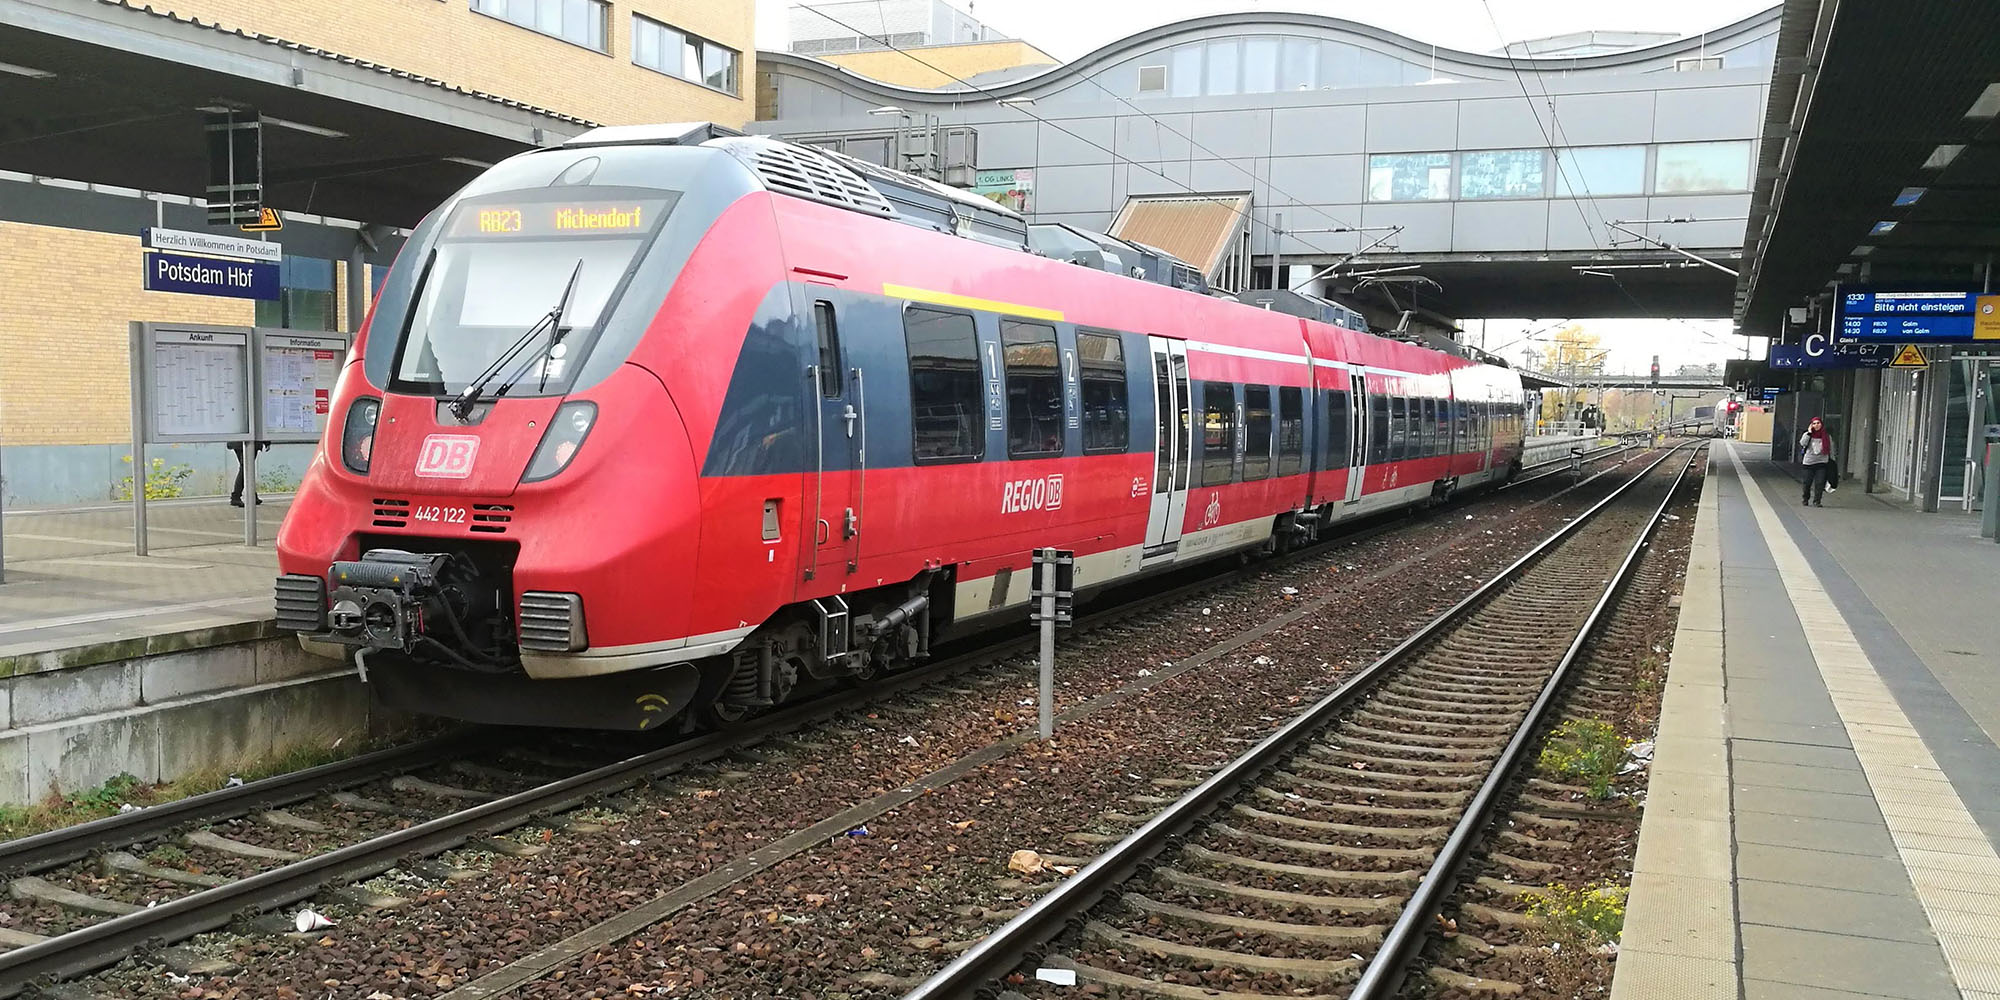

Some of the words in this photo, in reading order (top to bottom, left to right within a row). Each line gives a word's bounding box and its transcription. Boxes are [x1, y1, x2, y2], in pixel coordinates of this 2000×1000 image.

[479, 210, 522, 232] RB23
[555, 206, 641, 230] Michendorf
[155, 233, 187, 246] Herzlich
[188, 237, 235, 252] Willkommen
[236, 242, 244, 252] in
[245, 244, 278, 257] Potsdam!
[158, 259, 224, 285] Potsdam
[228, 266, 253, 288] Hbf
[1874, 303, 1895, 312] Bitte
[1896, 303, 1918, 311] nicht
[1920, 303, 1965, 313] einsteigen
[189, 333, 213, 342] Ankunft
[289, 338, 321, 347] Information
[1805, 334, 1825, 357] C
[988, 344, 997, 379] 1
[1066, 351, 1075, 382] 2
[422, 440, 472, 472] DB
[1001, 478, 1046, 514] REGIO
[1048, 479, 1062, 505] DB
[414, 505, 441, 522] 442
[443, 507, 466, 523] 122
